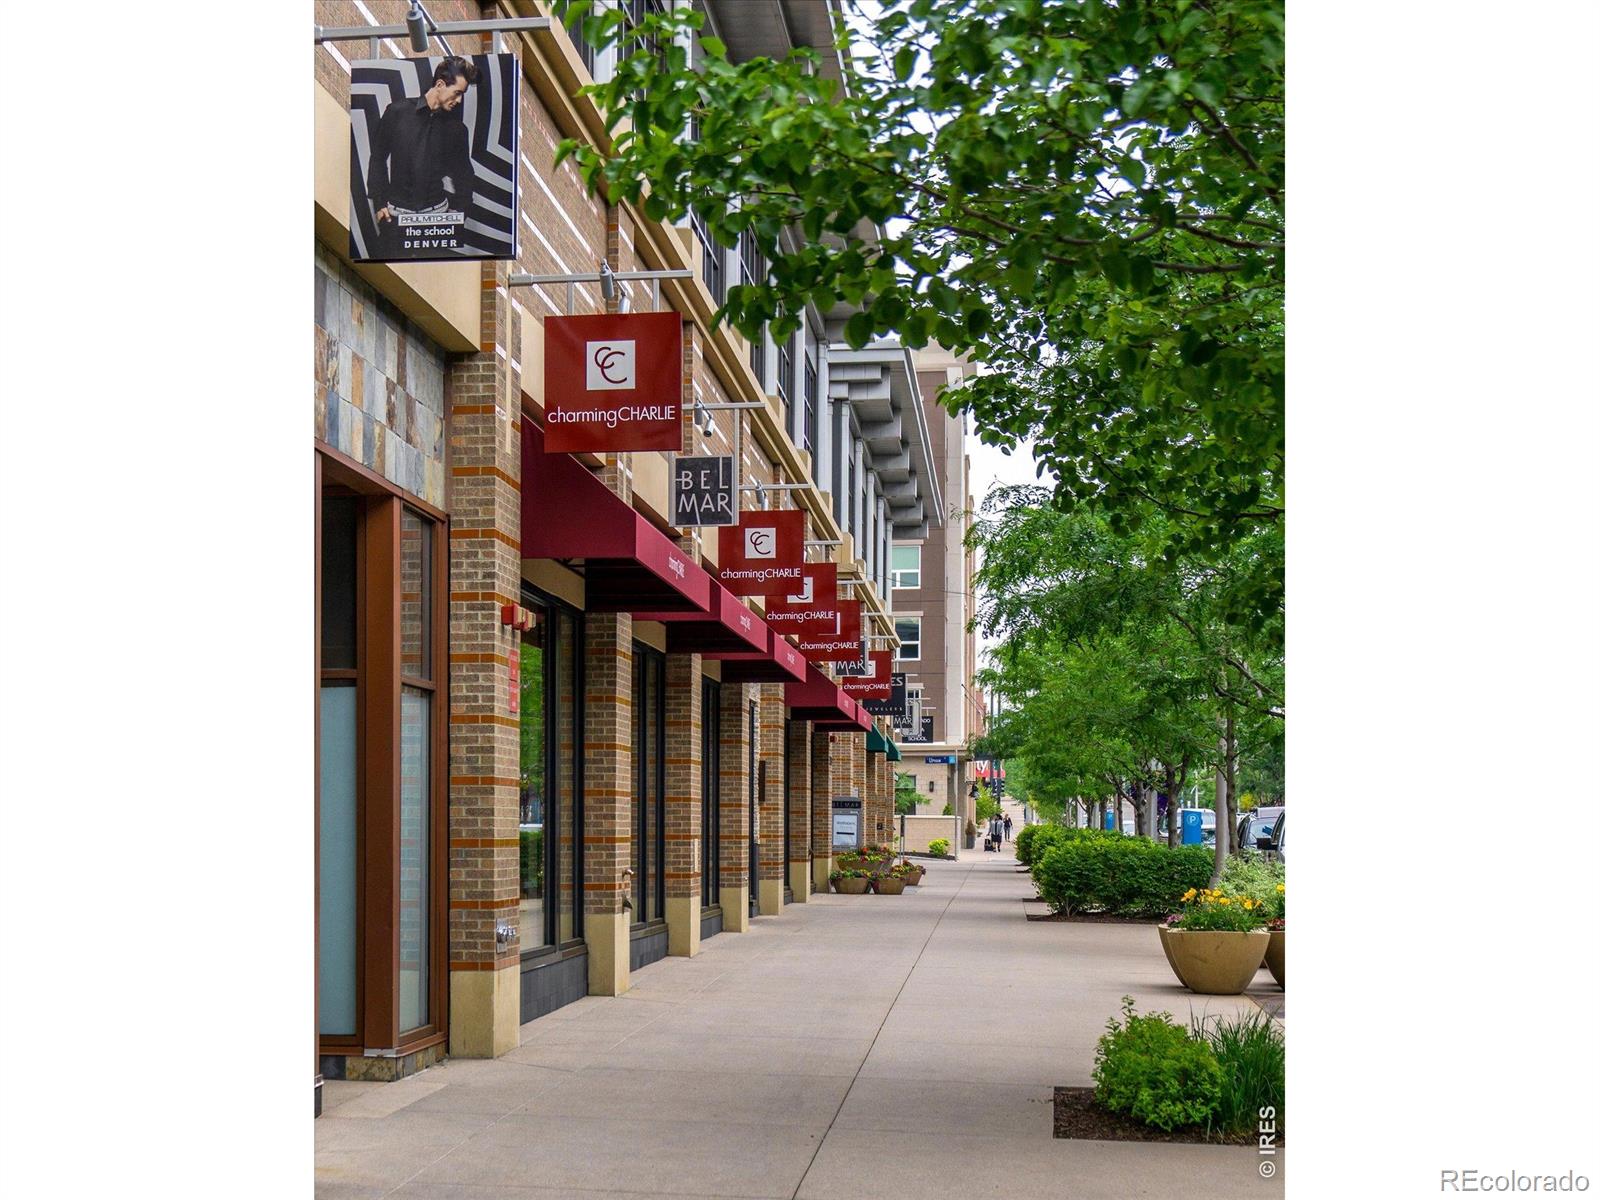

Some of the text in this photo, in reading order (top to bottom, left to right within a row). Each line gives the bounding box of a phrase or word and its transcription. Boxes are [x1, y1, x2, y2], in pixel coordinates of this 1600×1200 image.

[405, 225, 455, 236] the school
[404, 239, 457, 248] DENVER
[547, 405, 676, 428] charmingCHARLIE
[676, 456, 730, 490] BEL
[678, 493, 733, 525] MAR
[720, 567, 801, 583] charmingCHARLIE
[766, 611, 835, 623] charmingCHARLIE
[800, 642, 859, 652] charmingCHARLIE
[837, 660, 866, 676] MAR
[843, 683, 891, 692] charmingCHARLIE
